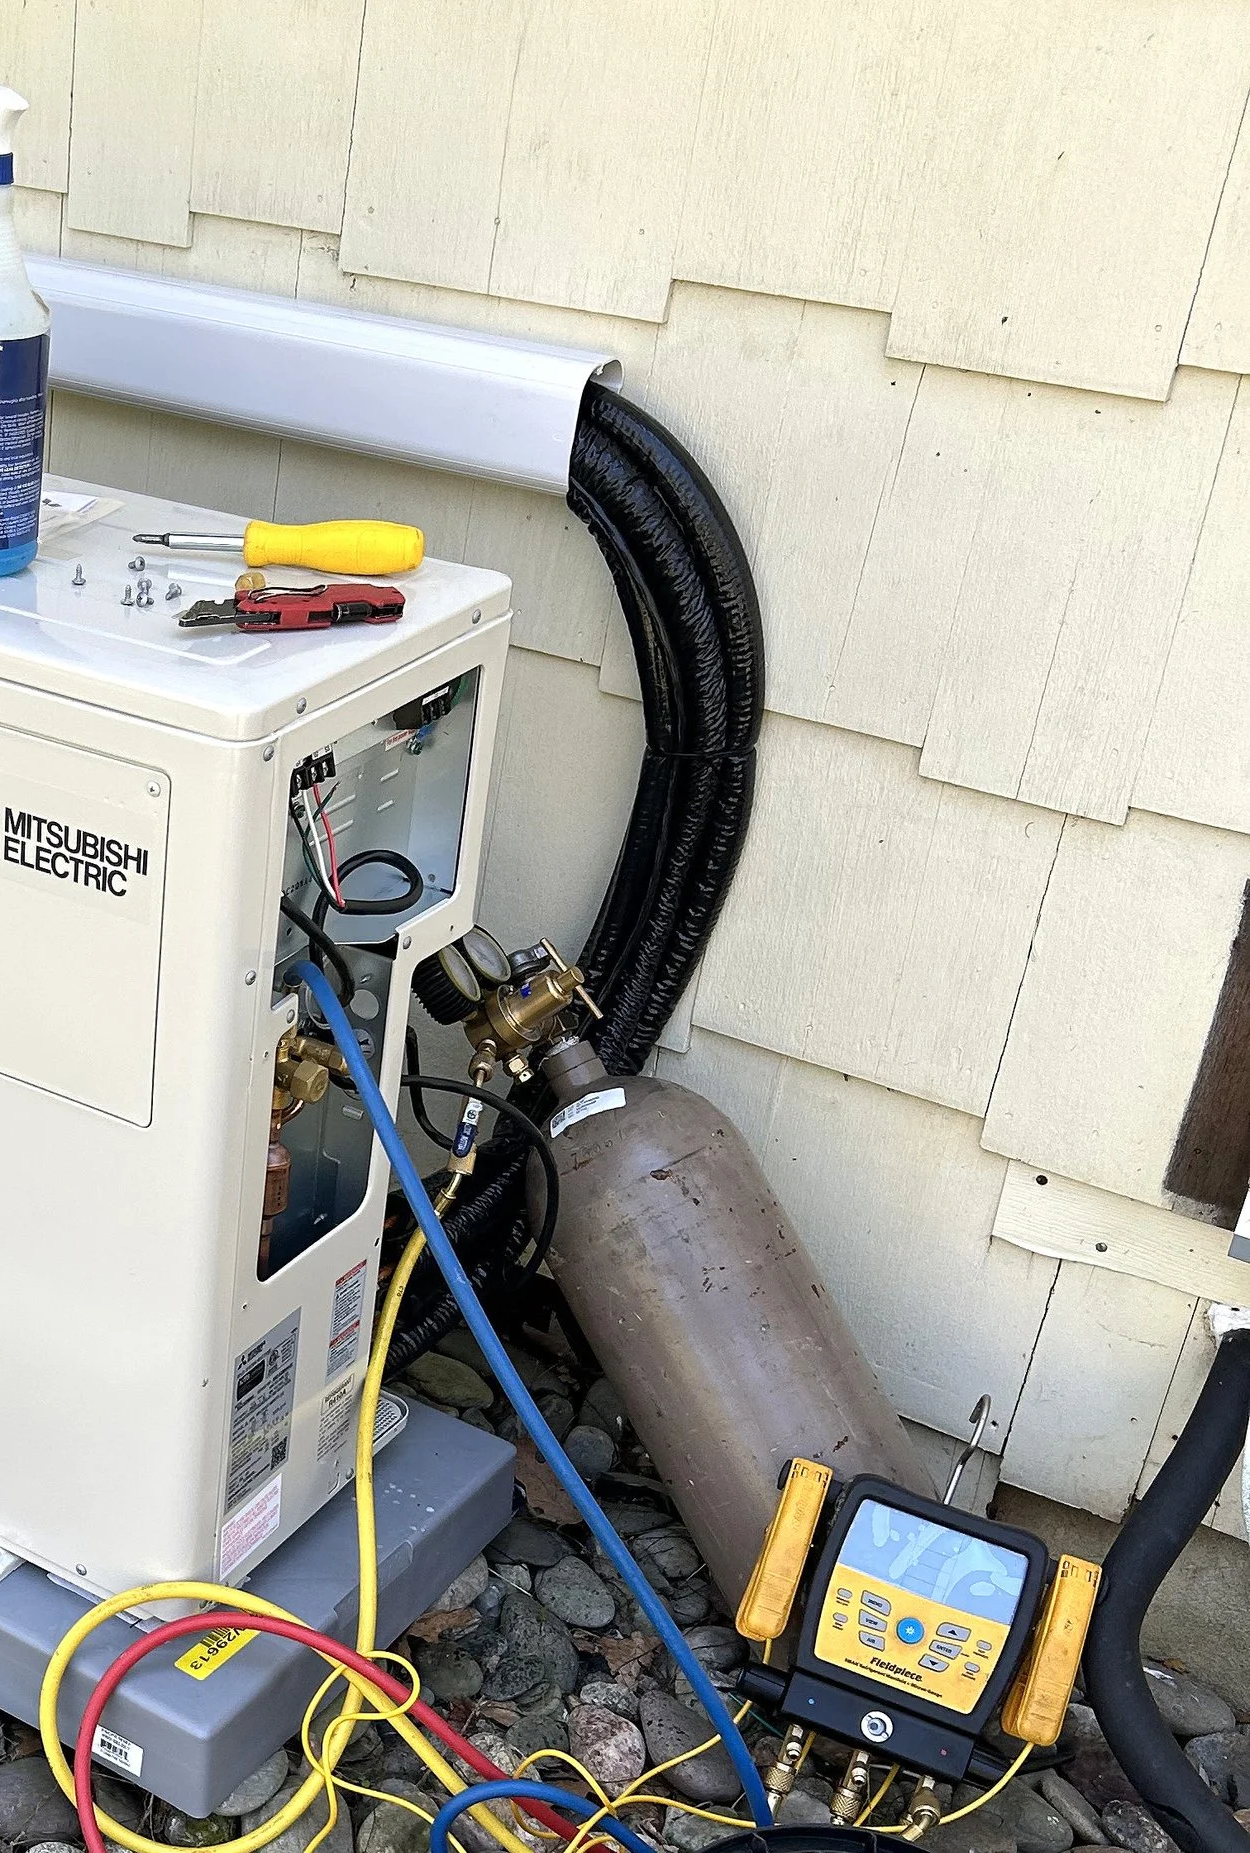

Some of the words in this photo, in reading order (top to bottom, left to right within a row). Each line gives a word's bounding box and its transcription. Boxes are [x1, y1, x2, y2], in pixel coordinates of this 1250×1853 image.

[4, 806, 149, 876] MITSUBISHI
[3, 835, 127, 897] ELECTRIC
[870, 1656, 923, 1682] Fieldpiece
[936, 1644, 952, 1654] ENTER
